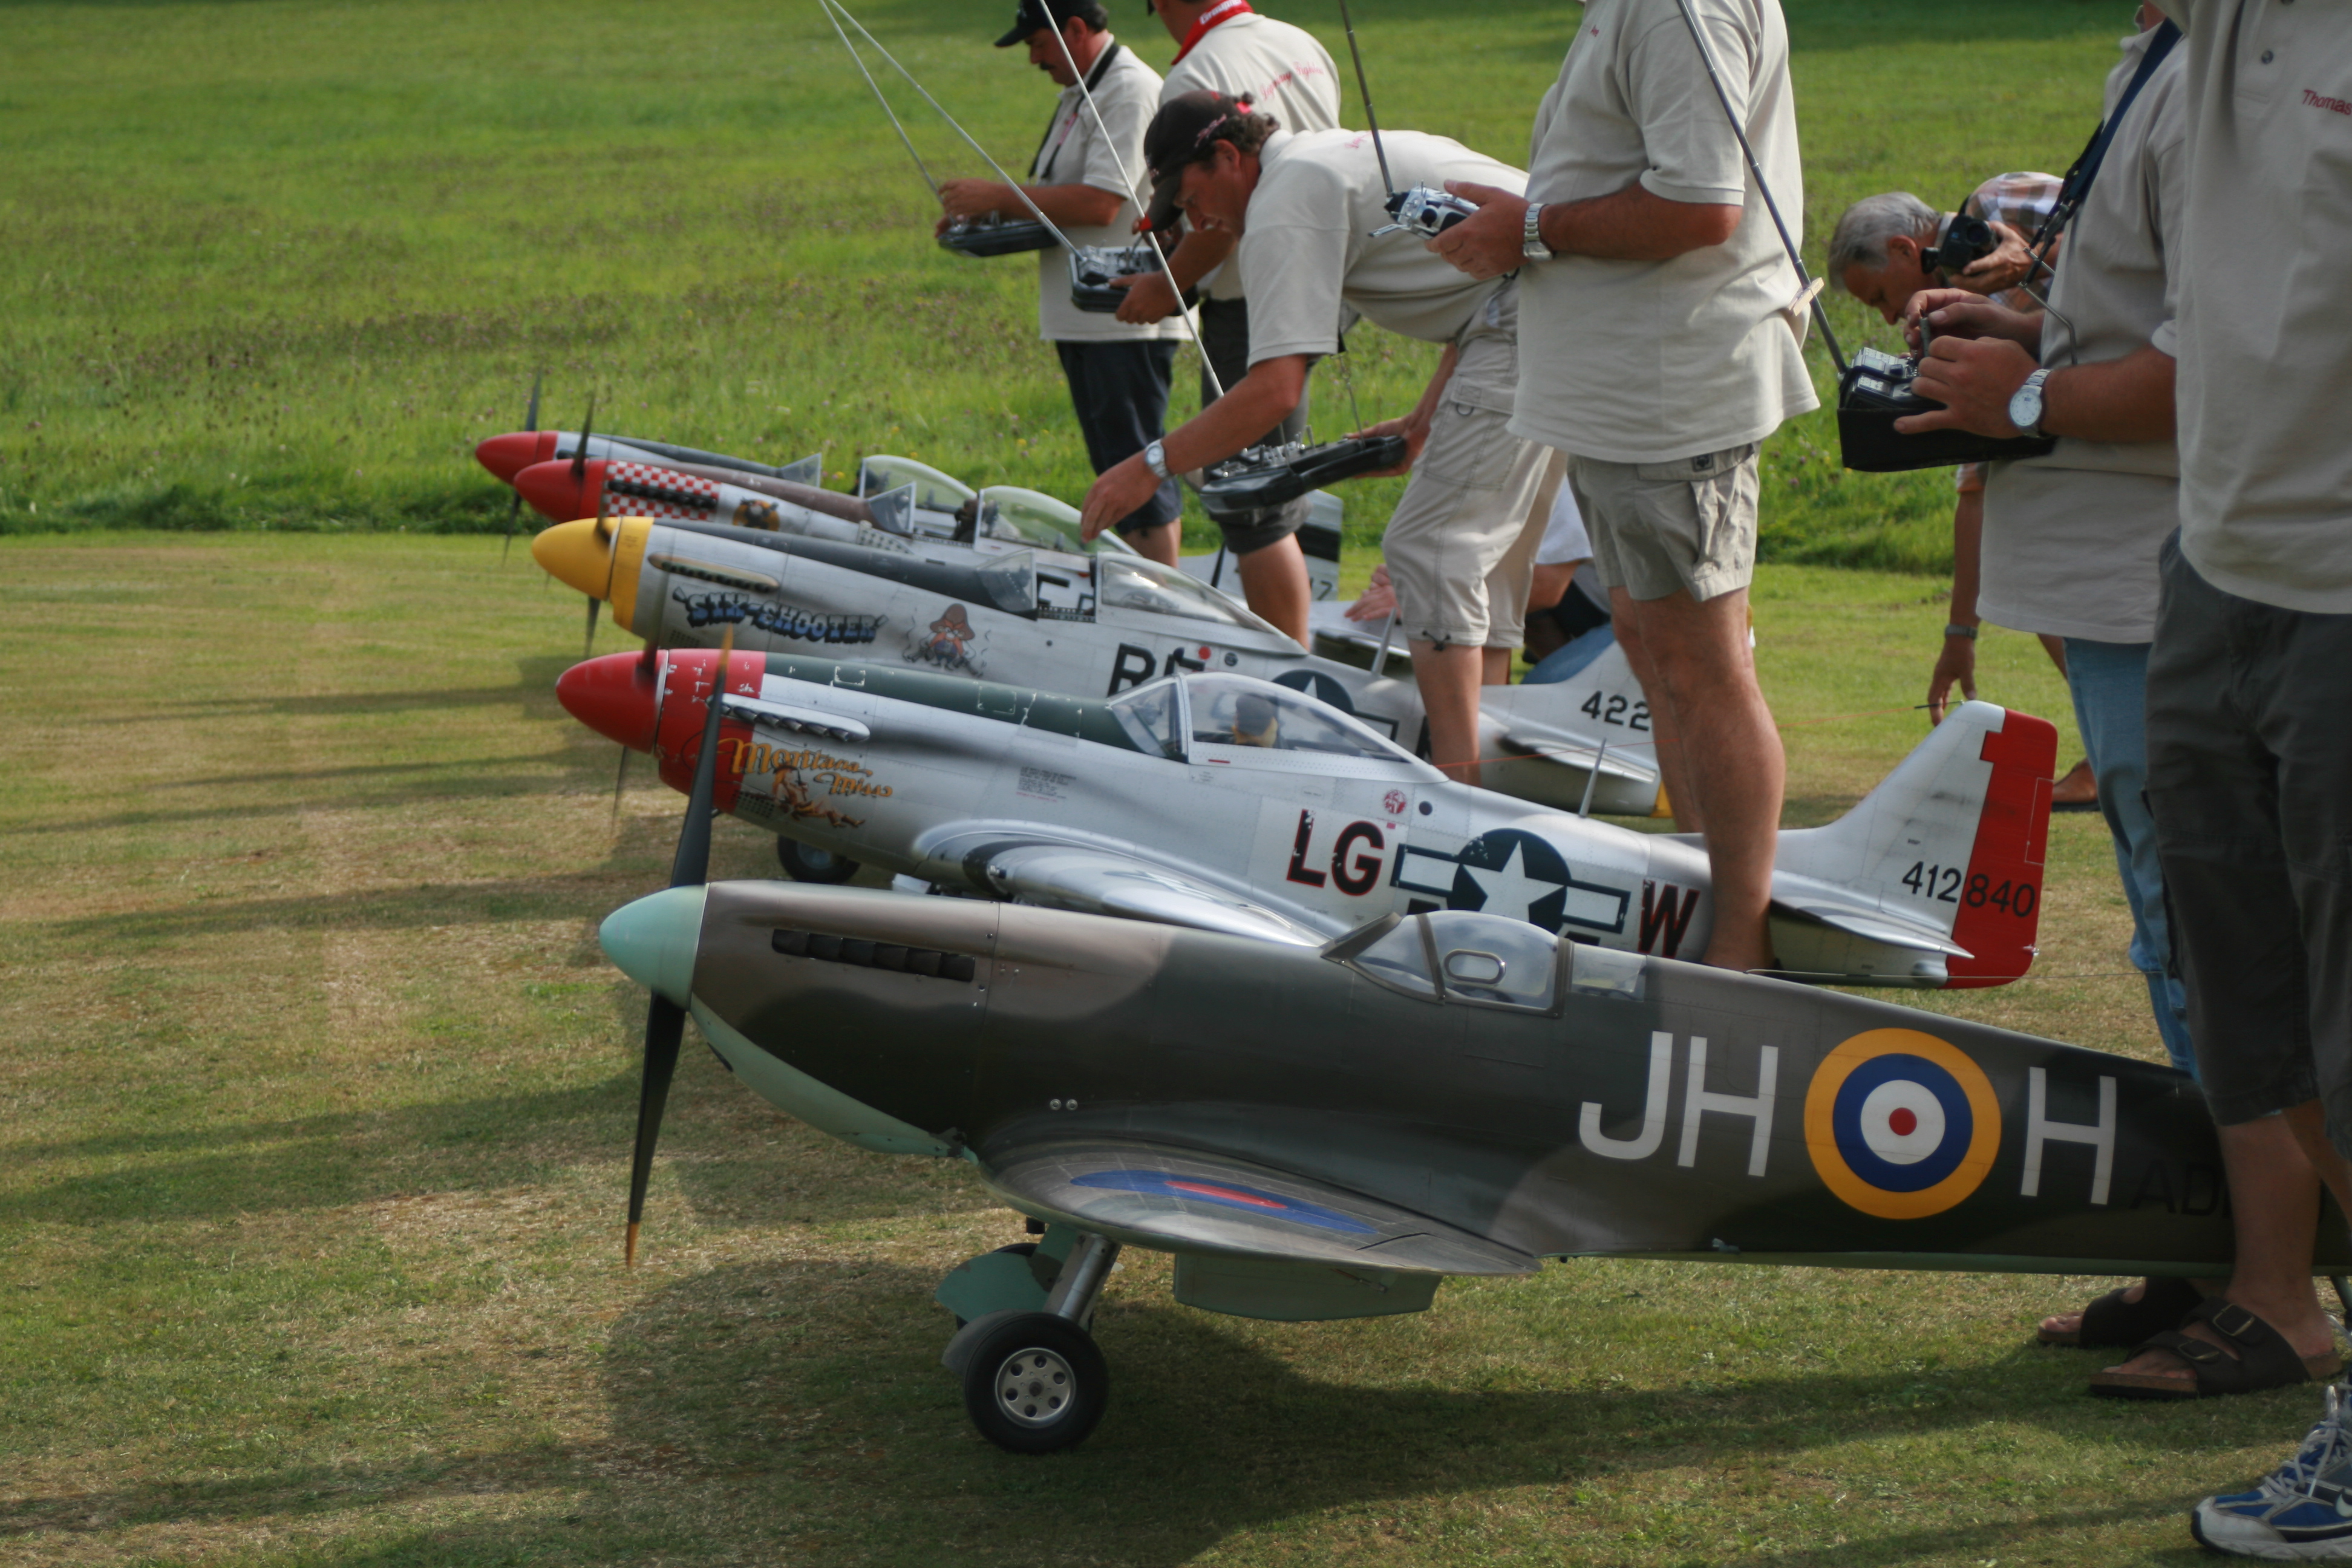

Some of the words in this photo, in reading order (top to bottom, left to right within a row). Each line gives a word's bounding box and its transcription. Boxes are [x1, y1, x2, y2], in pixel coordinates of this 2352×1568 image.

[2302, 89, 2352, 116] Thomas
[716, 737, 873, 777] Montana
[814, 771, 893, 798] Miss
[1287, 808, 1385, 897] LG
[1638, 879, 1700, 959] W
[1902, 861, 2035, 918] 412840
[1579, 1030, 1779, 1177] JH
[2020, 1066, 2116, 1206] H
[2129, 1159, 2232, 1220] AD
